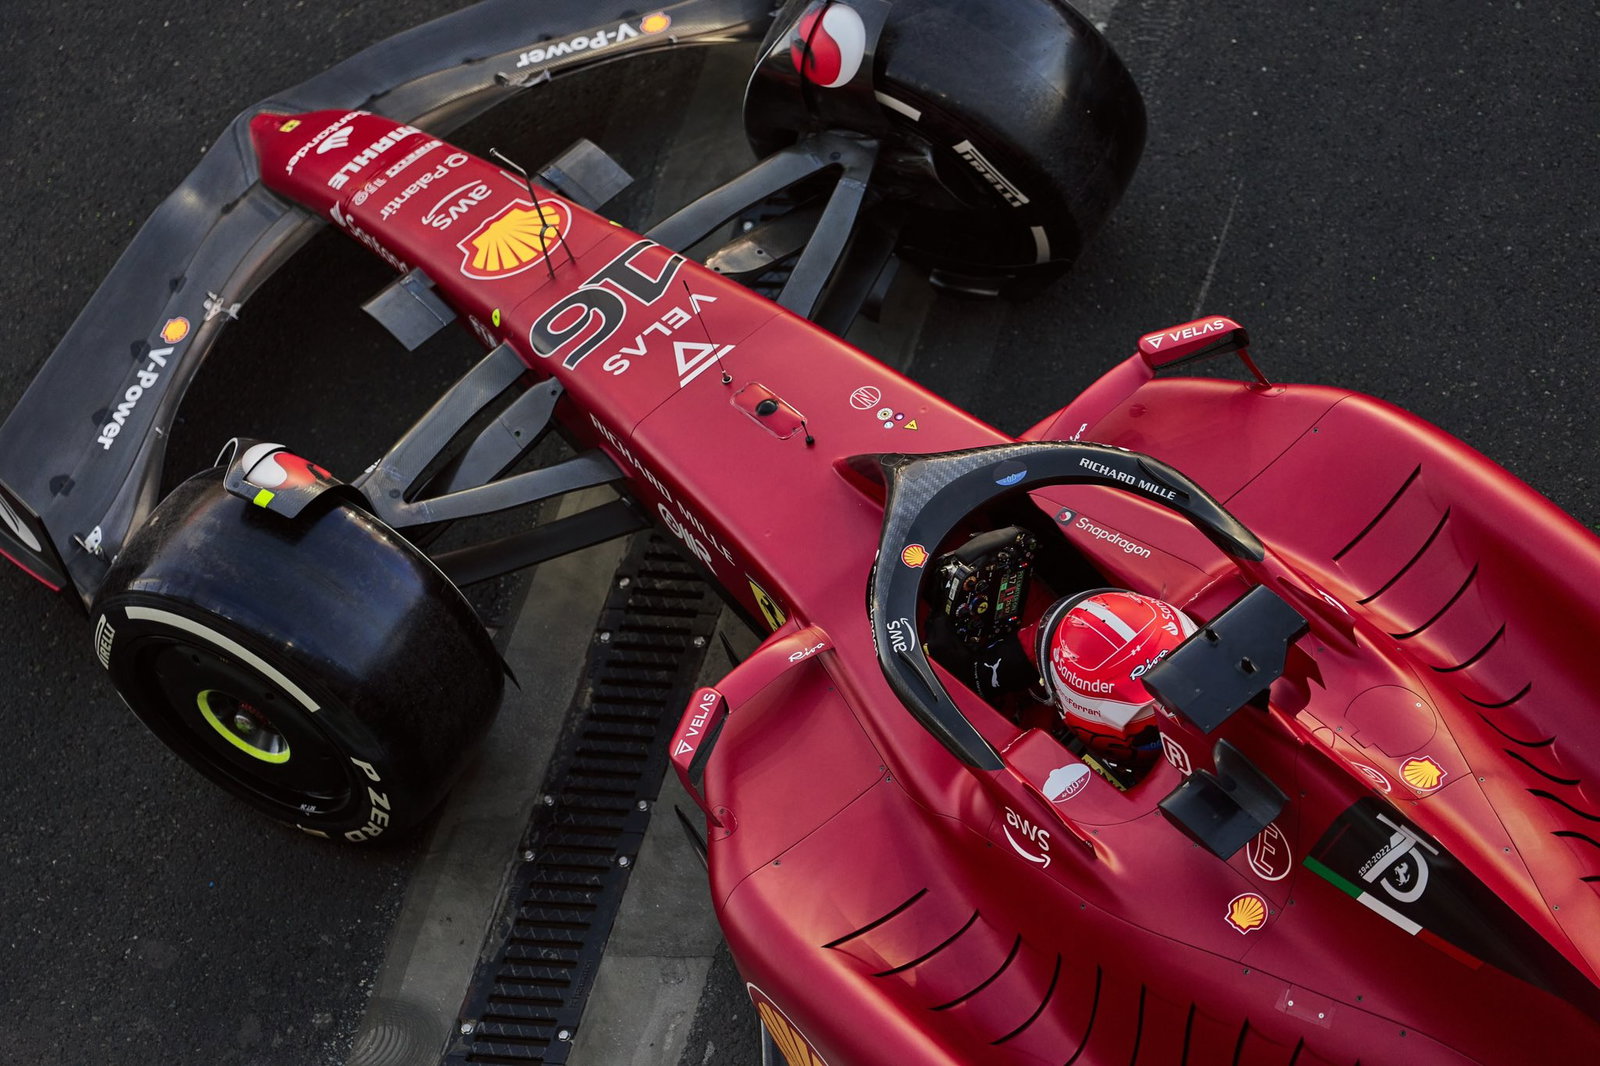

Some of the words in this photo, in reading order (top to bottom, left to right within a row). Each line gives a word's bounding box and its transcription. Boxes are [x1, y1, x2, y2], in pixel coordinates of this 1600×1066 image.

[517, 22, 639, 68] V-Power
[328, 125, 422, 190] MAHLE
[952, 139, 1030, 208] PIRELLI
[380, 164, 450, 221] Palantir
[431, 184, 492, 231] aws
[529, 238, 688, 371] 16
[602, 292, 719, 376] VELAS
[1169, 319, 1225, 342] VELAS
[97, 346, 175, 450] V-Power
[589, 412, 673, 504] RICHARD
[676, 500, 736, 567] MILLE
[1079, 457, 1136, 485] RICHARD
[1137, 478, 1177, 501] MILLE
[1075, 517, 1152, 559] Snapdragon
[94, 613, 116, 670] PIRELLI
[788, 643, 826, 663] Riva
[886, 620, 908, 654] aws
[1056, 657, 1116, 694] Santander
[1129, 649, 1169, 681] Riva
[686, 692, 717, 737] VELAS
[350, 756, 381, 782] P
[344, 786, 391, 842] ZERO
[1005, 806, 1050, 851] aws
